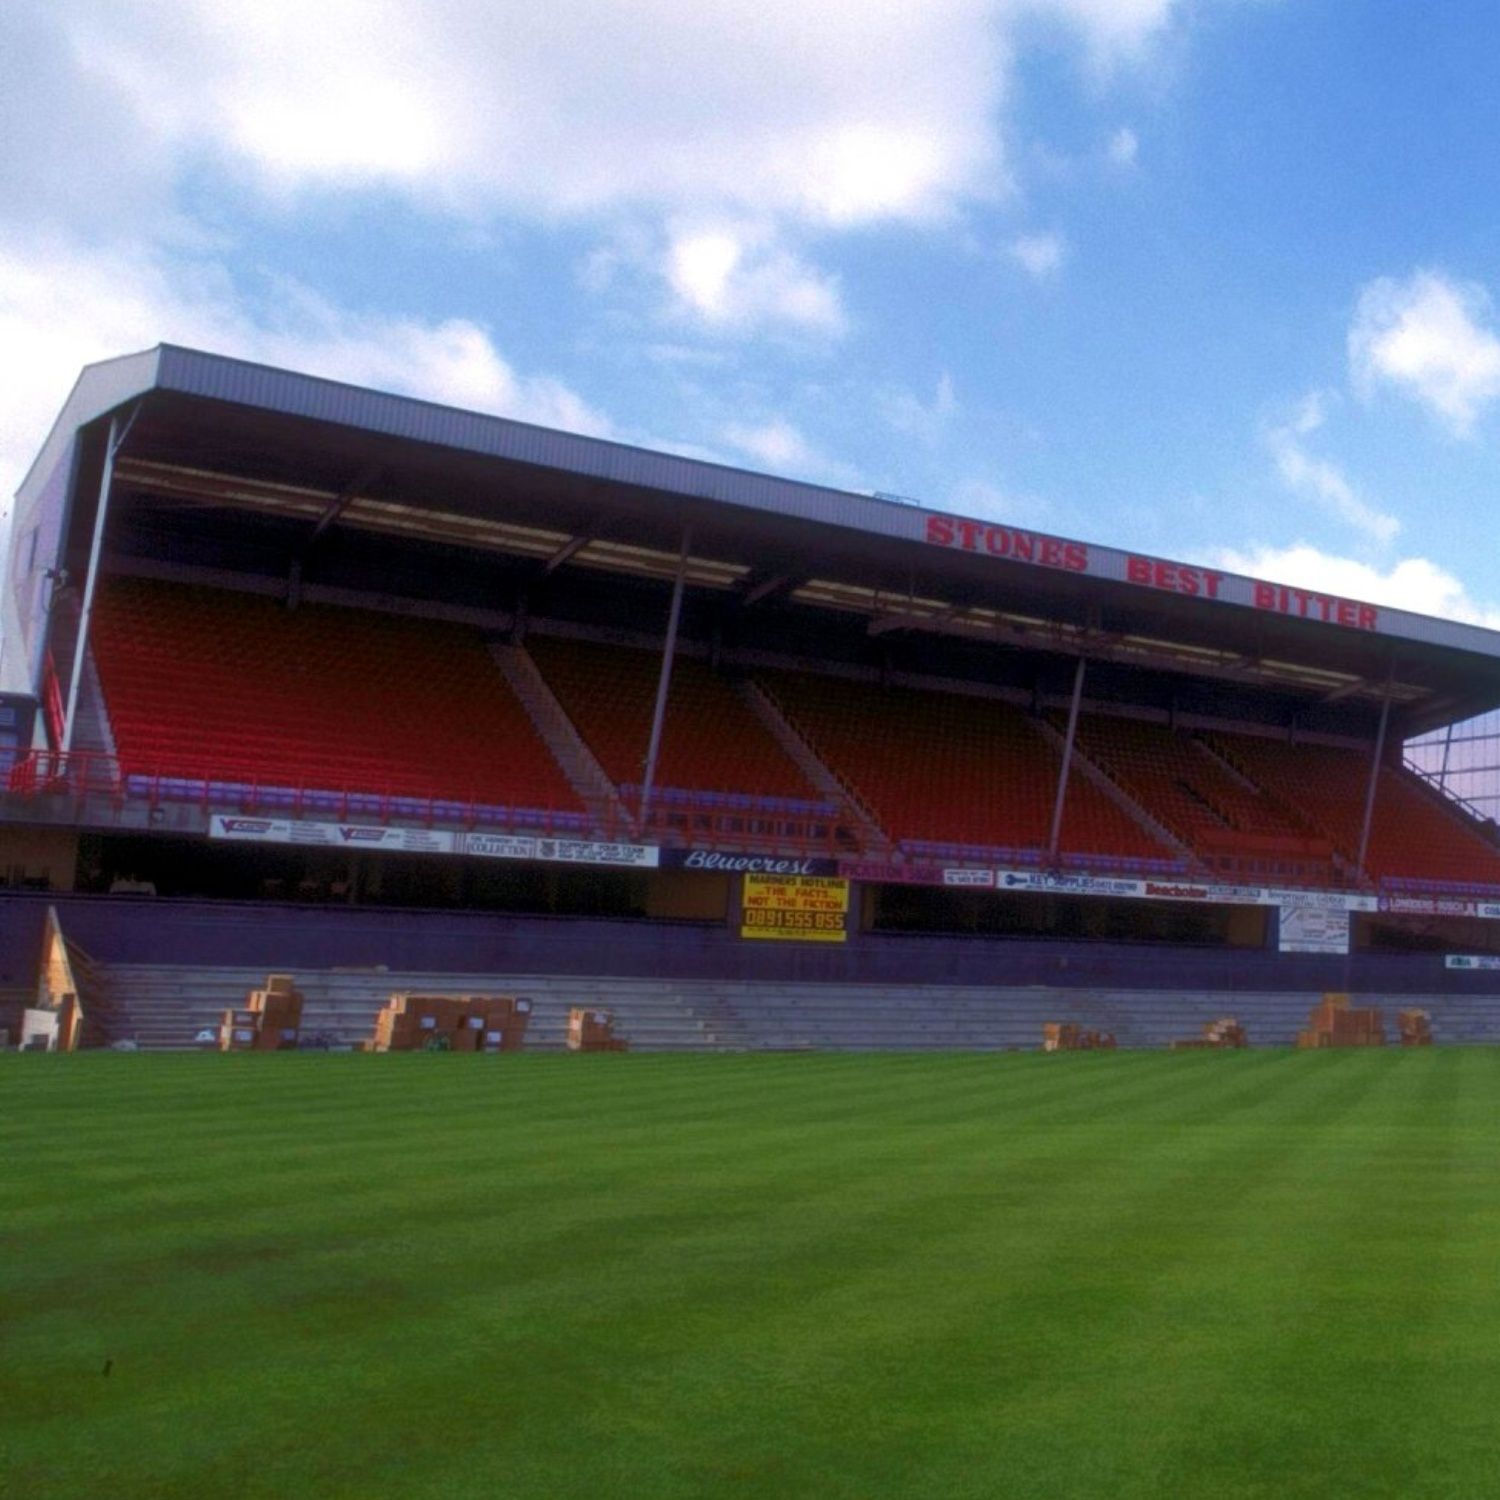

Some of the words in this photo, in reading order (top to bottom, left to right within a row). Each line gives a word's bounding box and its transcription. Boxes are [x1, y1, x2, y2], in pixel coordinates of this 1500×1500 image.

[926, 514, 1089, 574] STONES
[1126, 556, 1224, 599] BEST
[1252, 579, 1379, 631] BITTER
[684, 850, 814, 875] Bluecrest
[801, 877, 845, 888] HOTLINE
[747, 895, 769, 906] NOT
[777, 897, 796, 907] THE
[803, 898, 843, 910] FICTION
